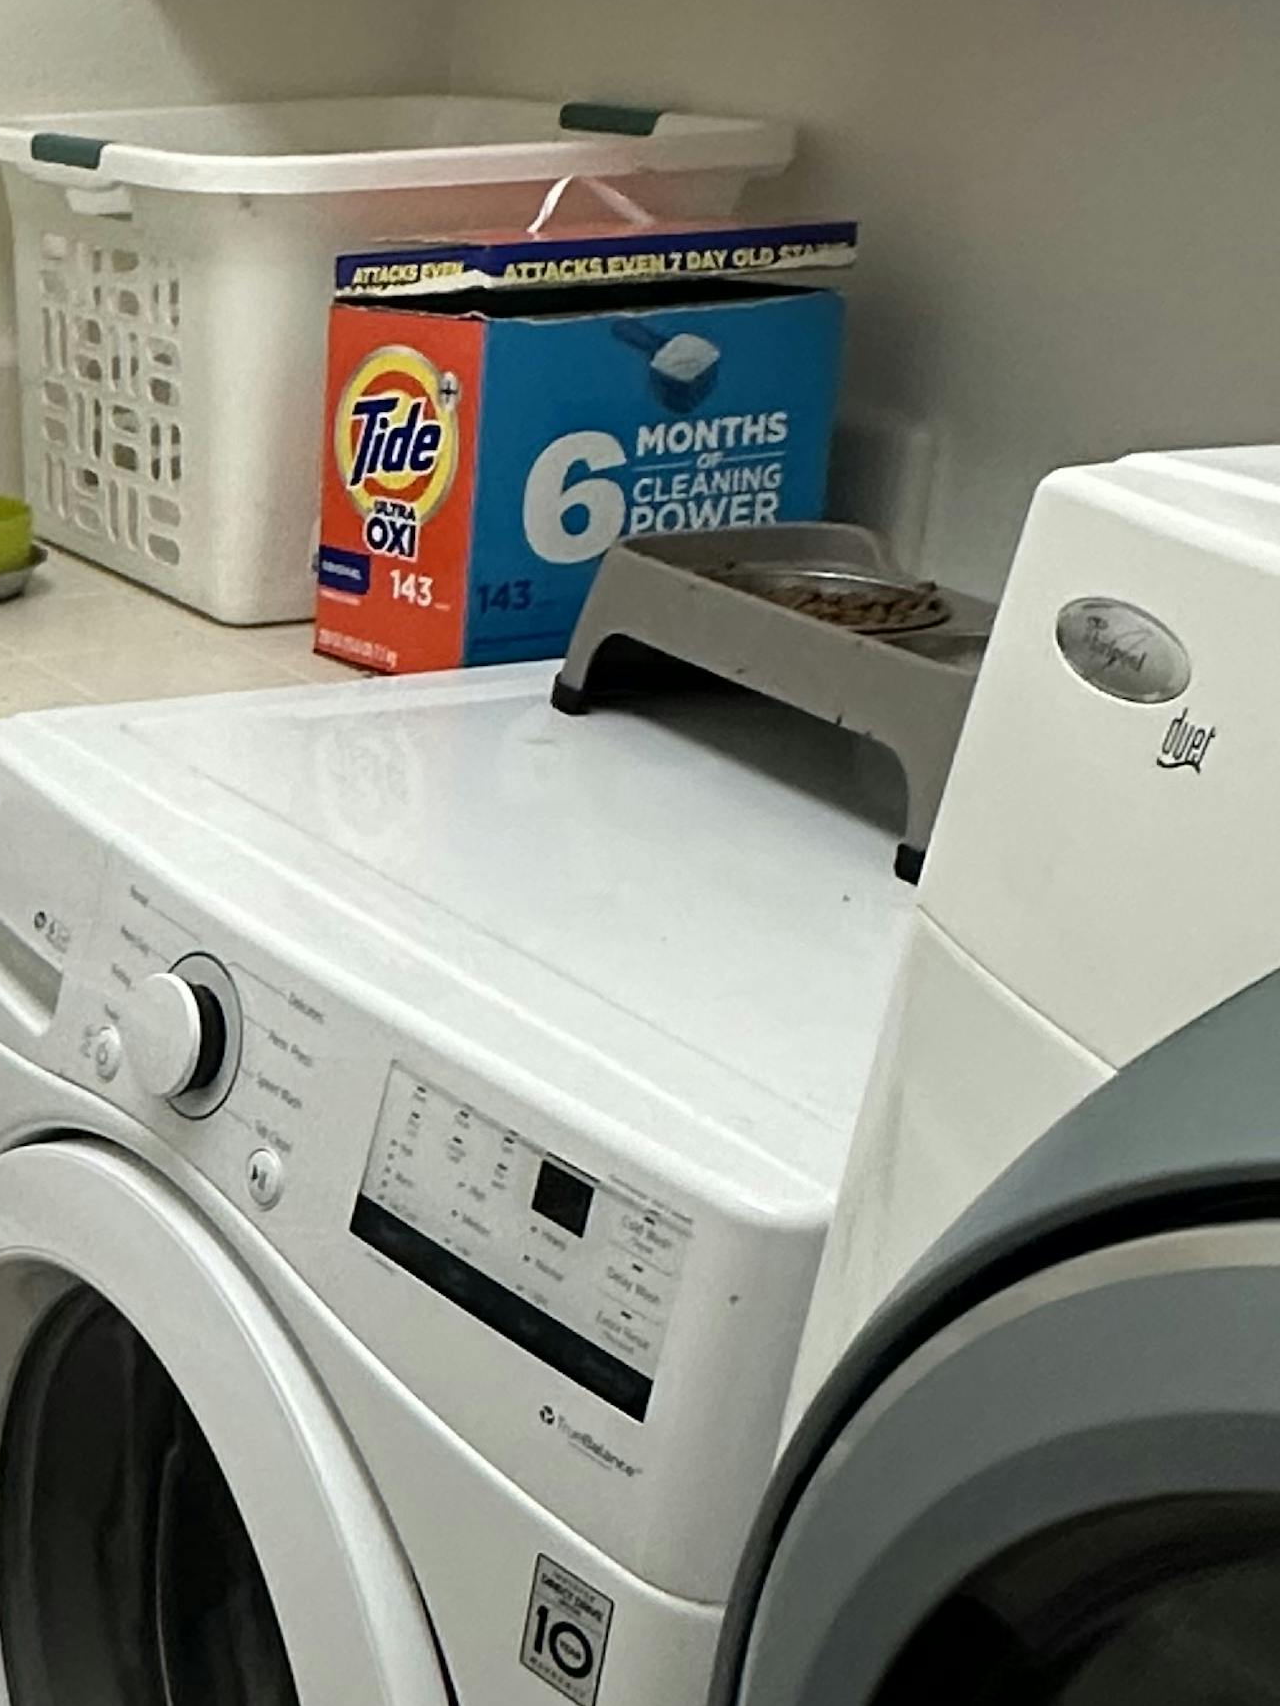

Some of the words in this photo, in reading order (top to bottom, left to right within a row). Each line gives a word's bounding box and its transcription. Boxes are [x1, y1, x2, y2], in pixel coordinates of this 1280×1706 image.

[352, 264, 419, 285] ATTACKS
[503, 257, 603, 282] ATTACKS
[607, 253, 666, 277] EVEN
[668, 253, 681, 272] 7
[687, 250, 728, 269] DAY
[732, 246, 775, 266] OLD
[347, 396, 442, 488] Tide
[635, 410, 789, 458] MONTHS
[695, 450, 724, 470] OF
[523, 429, 627, 565] 6
[632, 462, 783, 504] CLEANING
[373, 500, 417, 522] ULTRA
[629, 490, 779, 537] POWER
[366, 515, 417, 558] OXI
[389, 569, 434, 607] 143
[478, 578, 533, 617] 143
[1161, 706, 1217, 765] duet
[534, 1604, 595, 1680] 10
